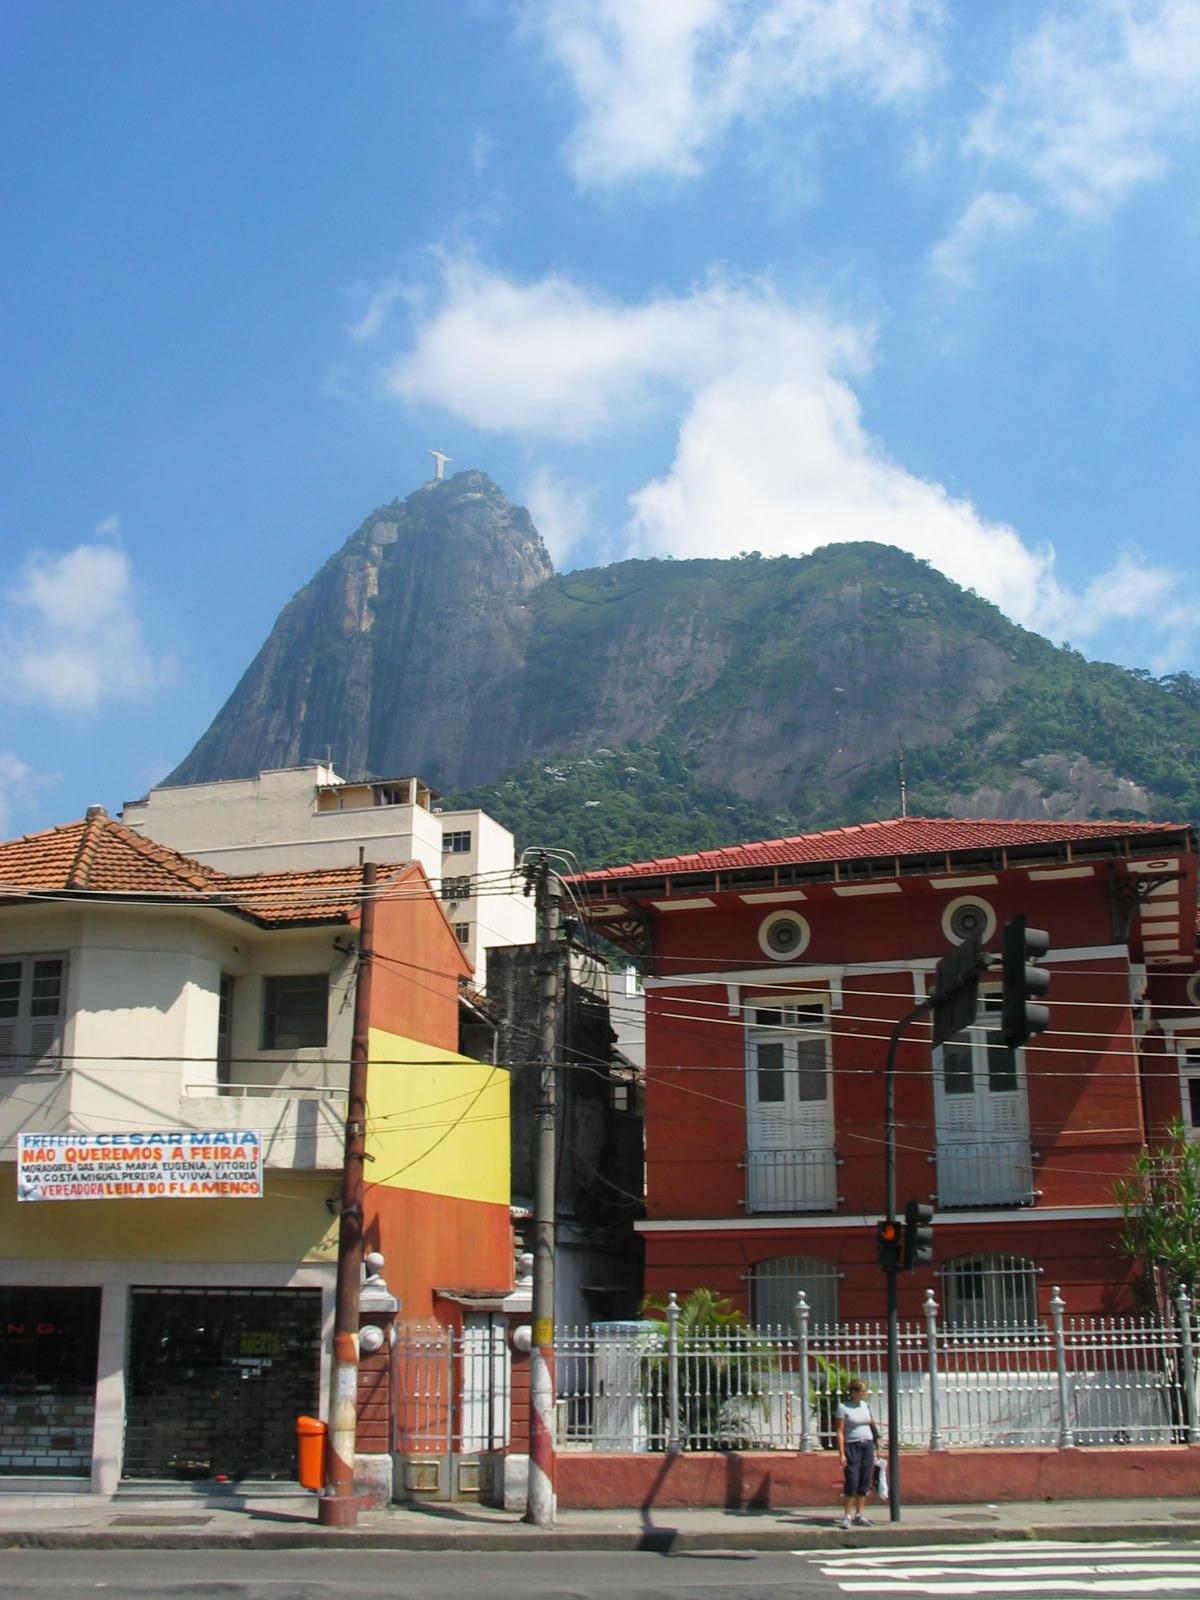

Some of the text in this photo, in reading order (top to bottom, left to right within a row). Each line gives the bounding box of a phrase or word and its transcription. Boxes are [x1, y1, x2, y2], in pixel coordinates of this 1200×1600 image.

[24, 1132, 258, 1147] PREFEITO CESAR MAIA
[65, 1147, 163, 1163] QUEREMOS
[171, 1146, 185, 1160] A
[190, 1146, 247, 1160] FEIRA
[22, 1164, 73, 1173] MORADORES
[98, 1163, 121, 1171] RUAS
[126, 1162, 158, 1171] MARIA
[44, 1173, 79, 1182] COSTA
[81, 1172, 120, 1182] MIGUEL
[122, 1172, 163, 1181] PEREIRA
[170, 1172, 177, 1180] E
[215, 1171, 257, 1180] LACERDA
[40, 1182, 260, 1197] VEREADORA LEILA DO FLAMENGO
